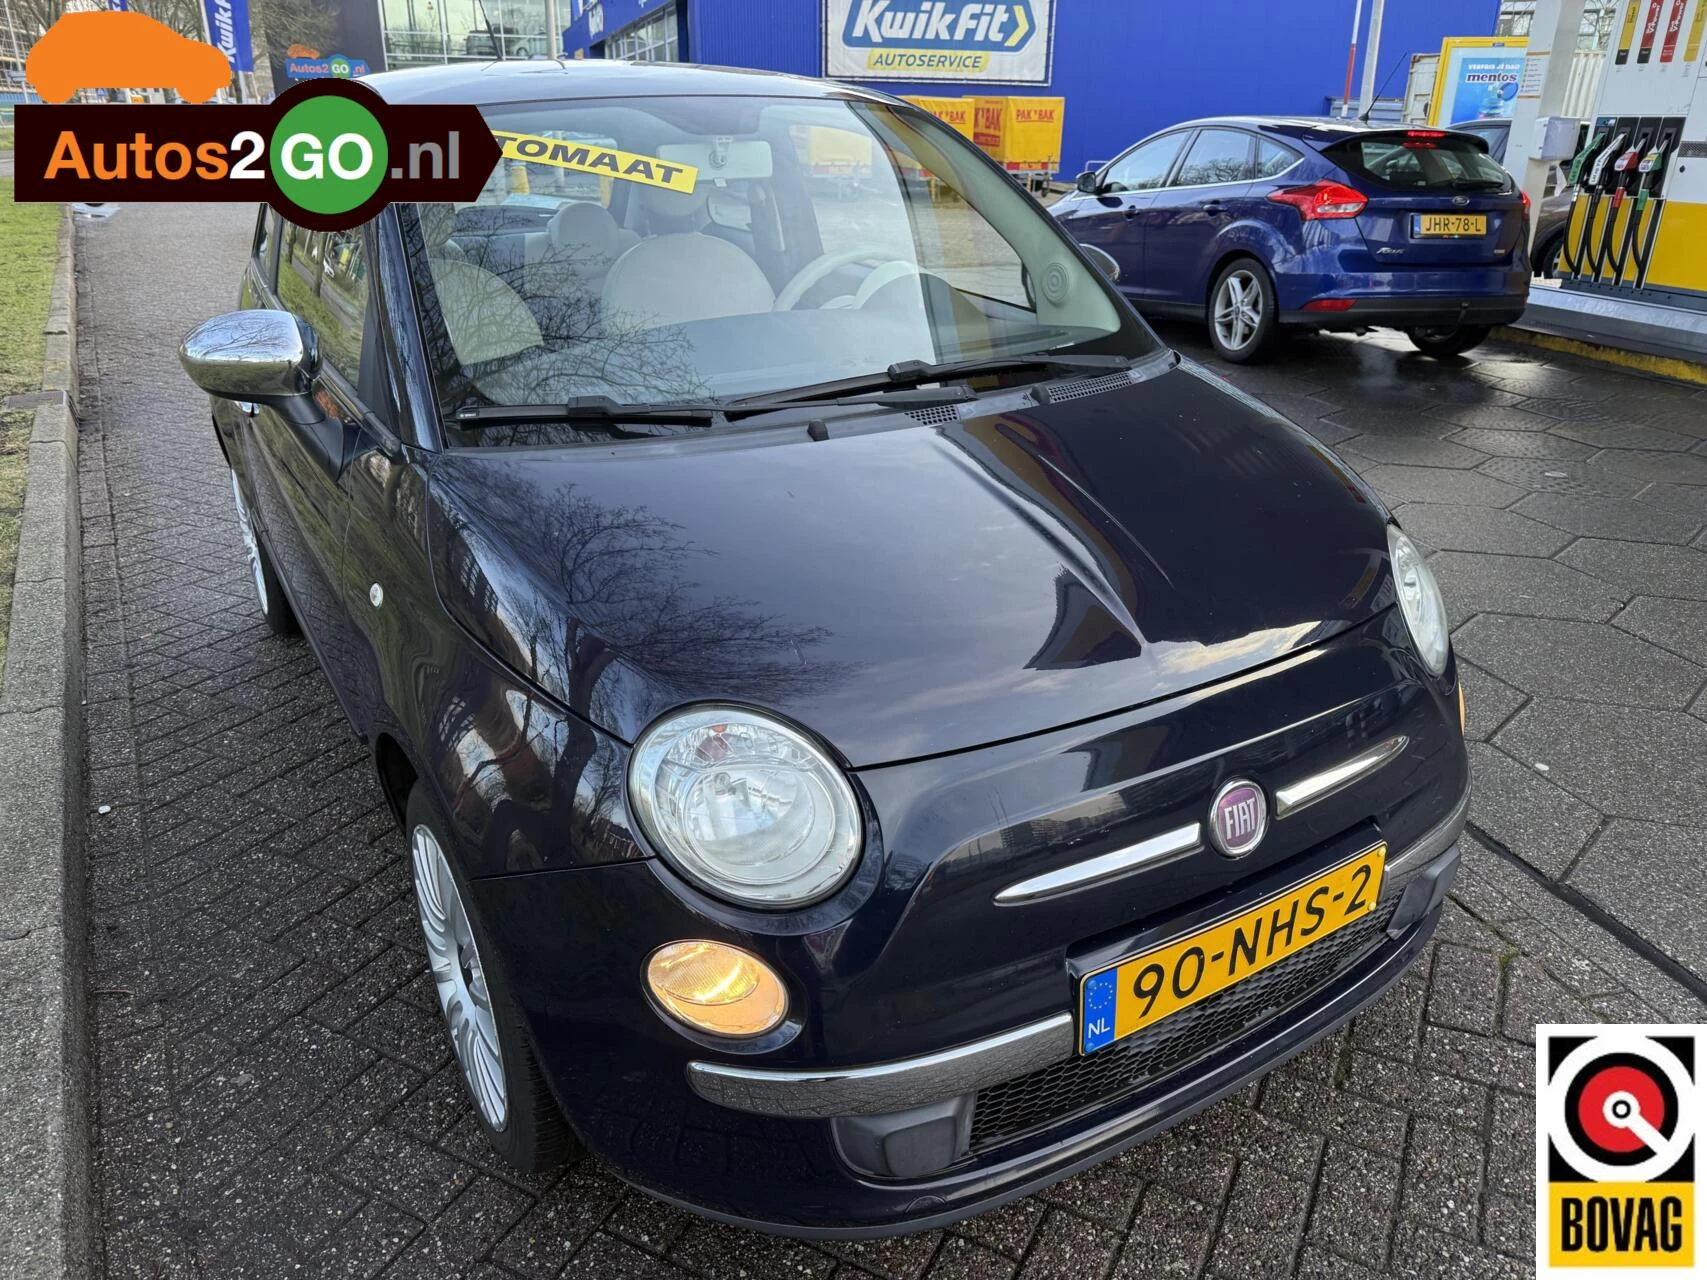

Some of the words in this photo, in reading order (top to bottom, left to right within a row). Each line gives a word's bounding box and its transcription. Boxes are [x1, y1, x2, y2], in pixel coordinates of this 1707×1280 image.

[873, 54, 983, 69] AUTOSERVICE
[1466, 72, 1518, 82] mentos
[495, 135, 683, 184] TOMAAT
[1425, 217, 1482, 232] JHR-78-L
[1223, 797, 1256, 840] FIAT
[1133, 864, 1371, 1019] 90-NHS-2
[1088, 1017, 1111, 1039] NL
